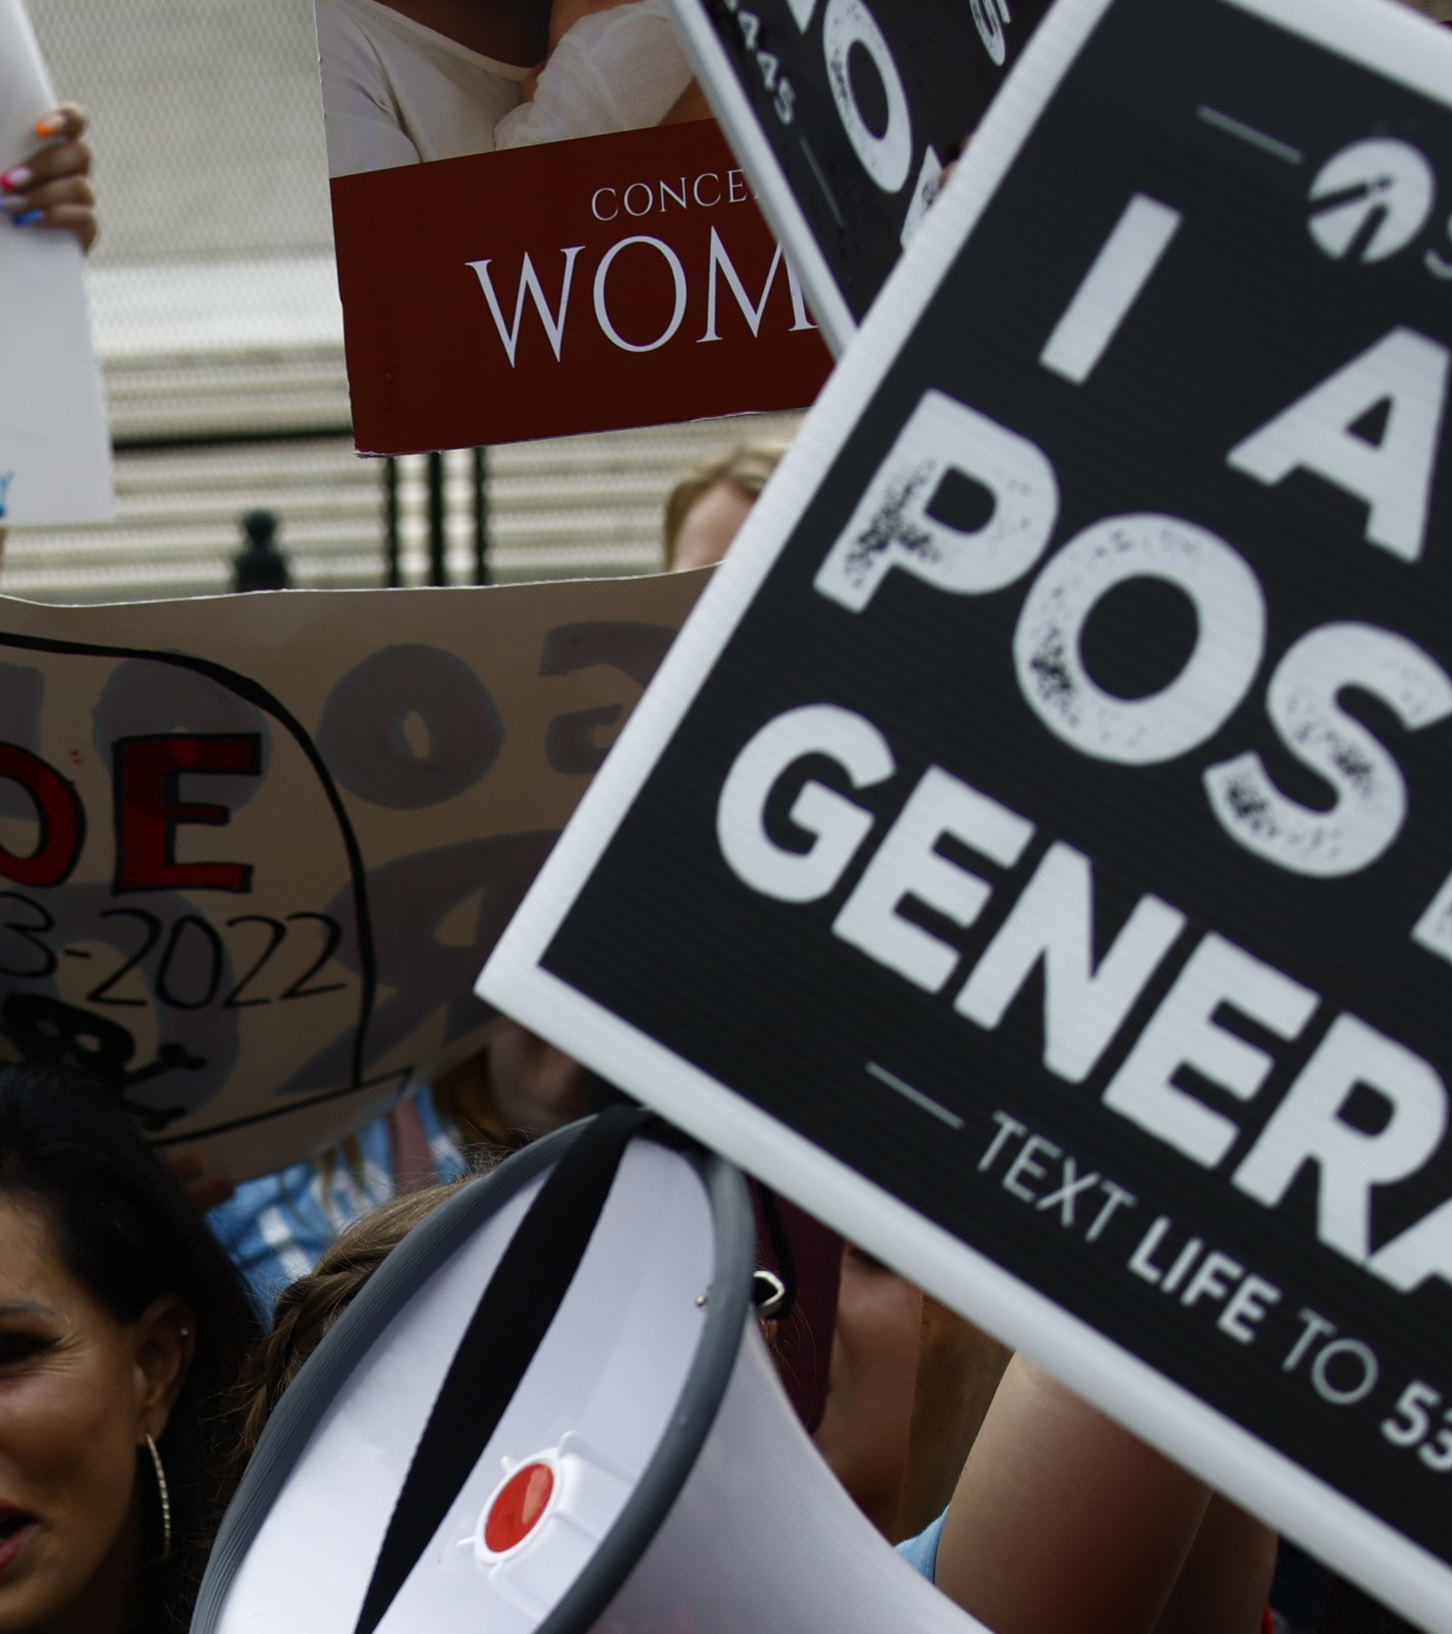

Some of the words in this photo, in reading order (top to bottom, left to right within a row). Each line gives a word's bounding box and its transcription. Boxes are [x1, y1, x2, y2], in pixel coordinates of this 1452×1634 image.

[1039, 194, 1182, 384] I
[976, 1108, 1138, 1243] TEXT
[1127, 1216, 1281, 1342] LIFE
[1280, 1310, 1380, 1406] TO
